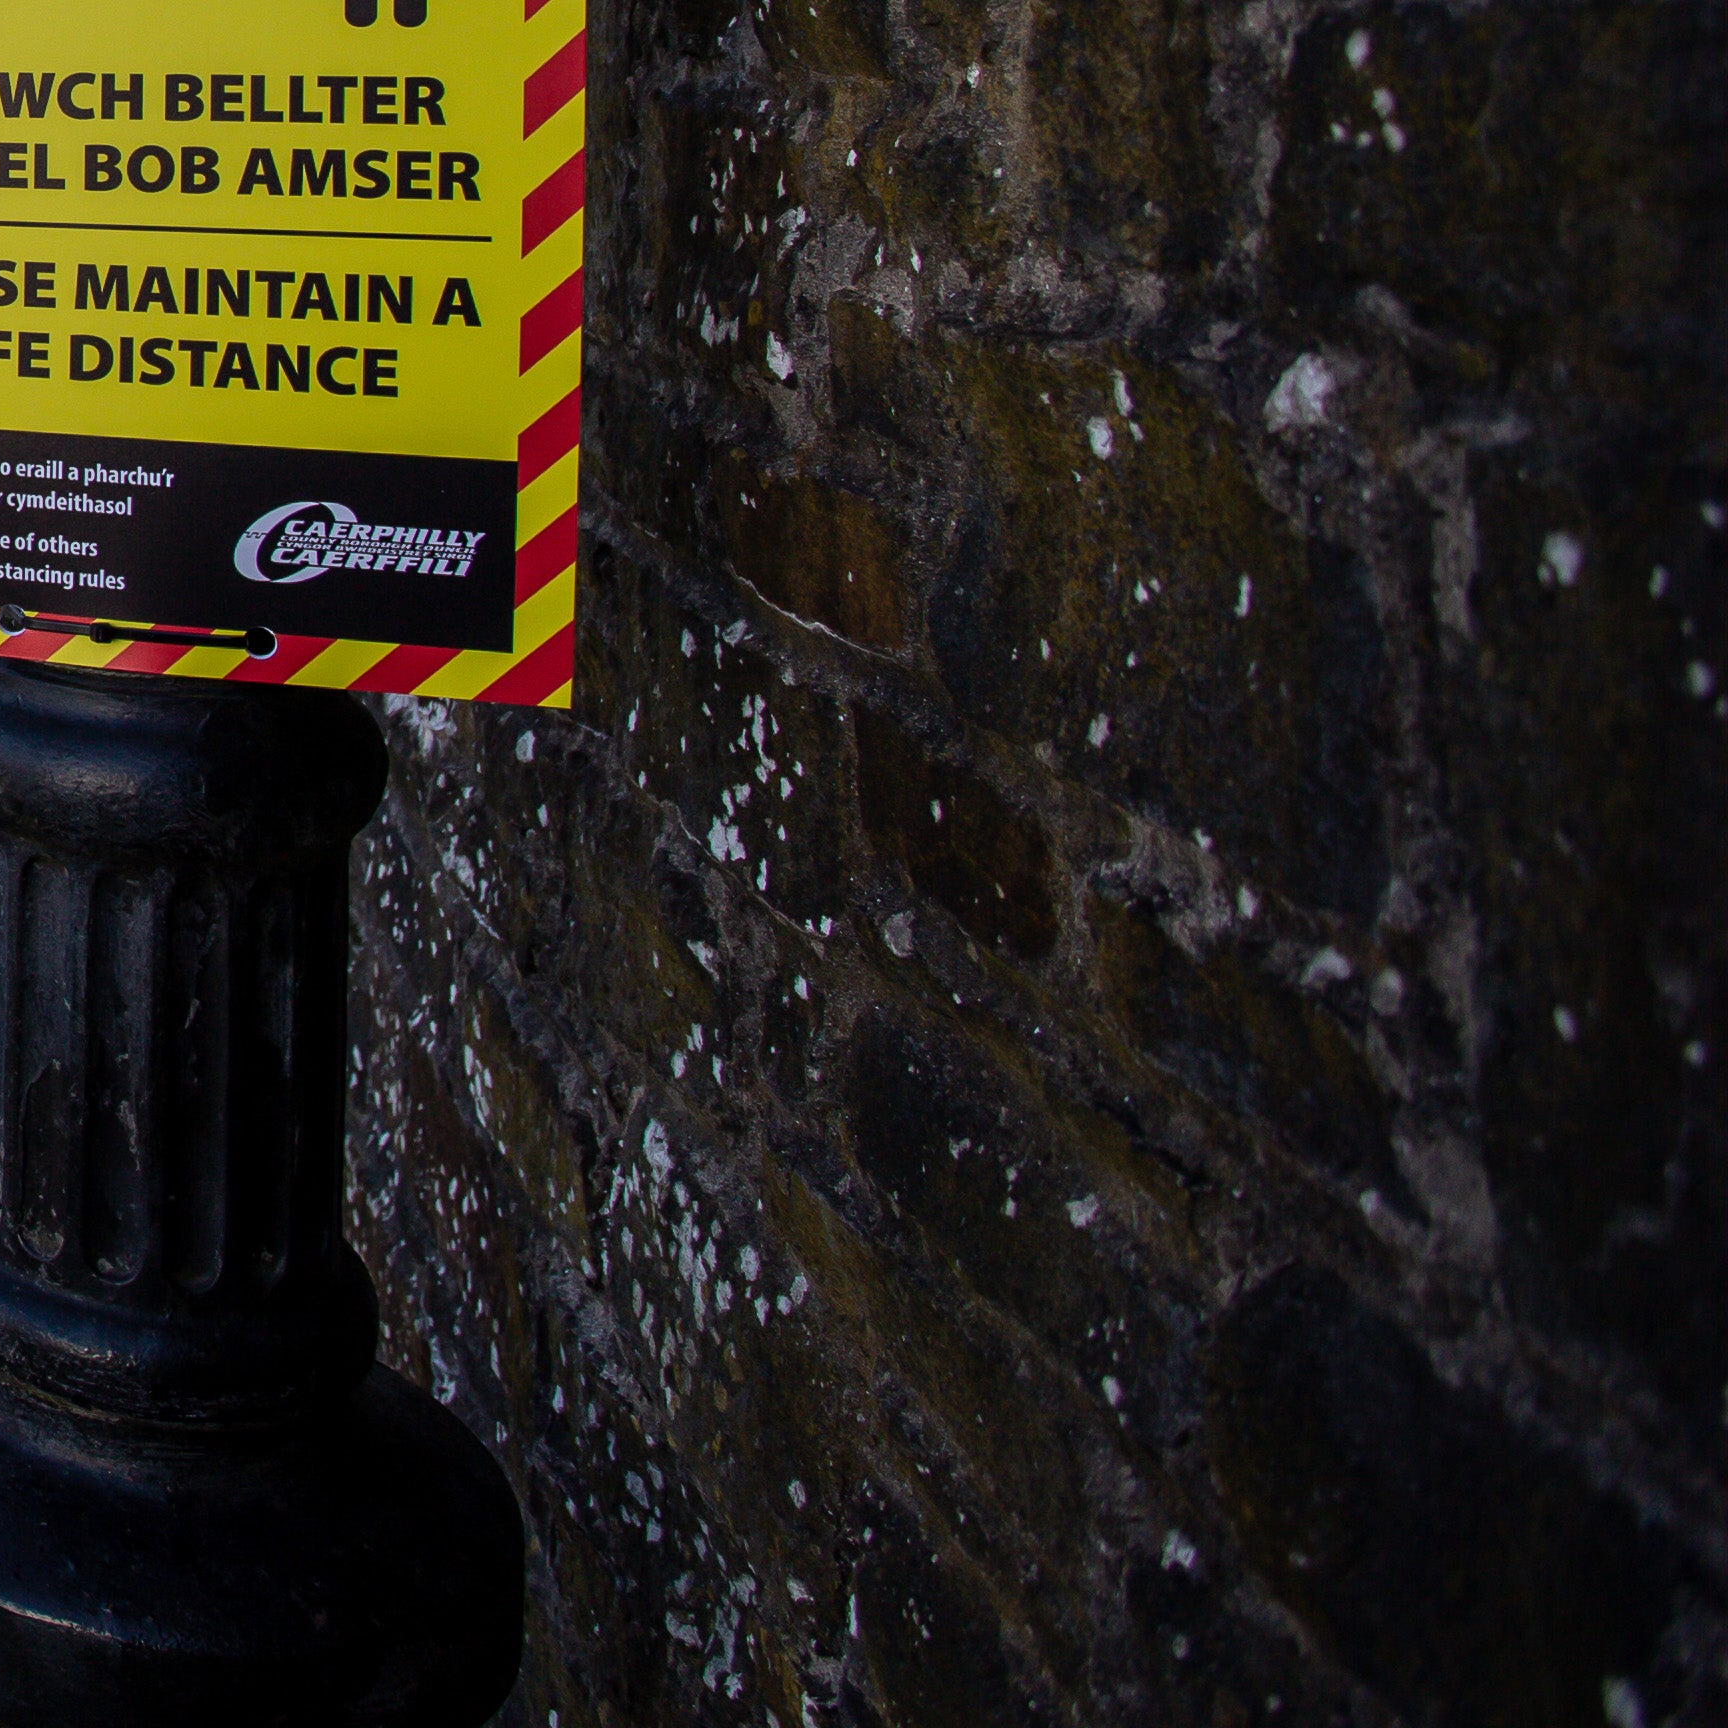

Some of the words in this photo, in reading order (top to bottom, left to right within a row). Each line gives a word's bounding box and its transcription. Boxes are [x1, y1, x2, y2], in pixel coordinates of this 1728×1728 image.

[164, 73, 447, 126] BELLTER
[84, 144, 220, 195] BOB
[236, 147, 481, 202] AMSER
[74, 263, 414, 325] MAINTAIN
[431, 277, 482, 328] A
[69, 334, 399, 398] DISTANCE
[0, 461, 12, 476] o
[15, 459, 64, 480] eraill
[67, 466, 79, 481] a
[83, 462, 175, 488] pharchu'r
[6, 489, 133, 516] cymdeithasol
[14, 532, 36, 552] of
[37, 533, 98, 557] others
[277, 541, 332, 551] CYNGOR
[280, 535, 337, 545] COUNTY
[340, 539, 412, 550] BOROUGH
[415, 545, 476, 555] COUNCIL
[284, 520, 486, 548] CAERPHILLY
[270, 548, 472, 577] CAERFFILI
[78, 568, 126, 591] rules
